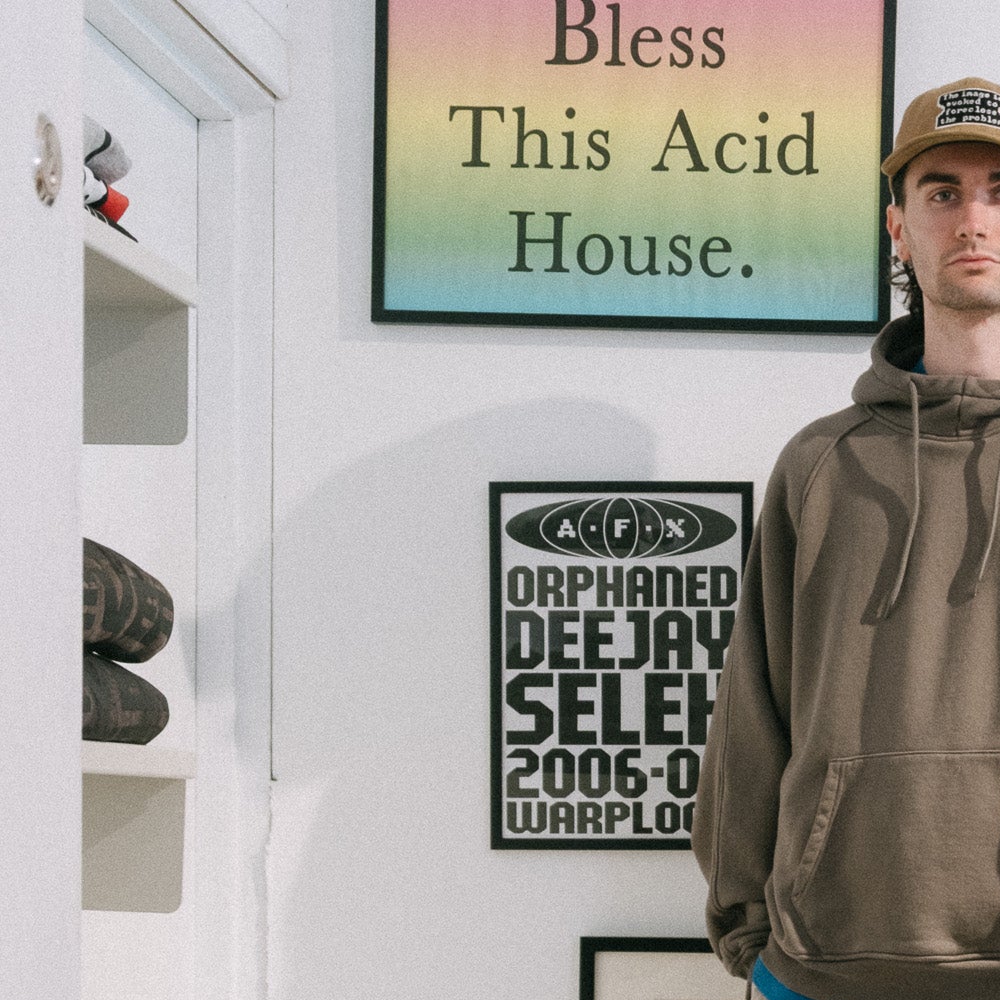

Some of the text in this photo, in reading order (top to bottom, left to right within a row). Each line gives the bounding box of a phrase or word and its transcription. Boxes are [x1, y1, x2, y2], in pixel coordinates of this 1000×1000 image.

[545, 0, 727, 69] Bless
[945, 106, 997, 115] foreclose
[946, 98, 981, 107] evoked
[962, 90, 990, 98] image
[449, 105, 820, 176] This Acid
[507, 210, 755, 279] House.
[507, 565, 738, 608] ORPHANED
[505, 610, 737, 670] DEEJAY
